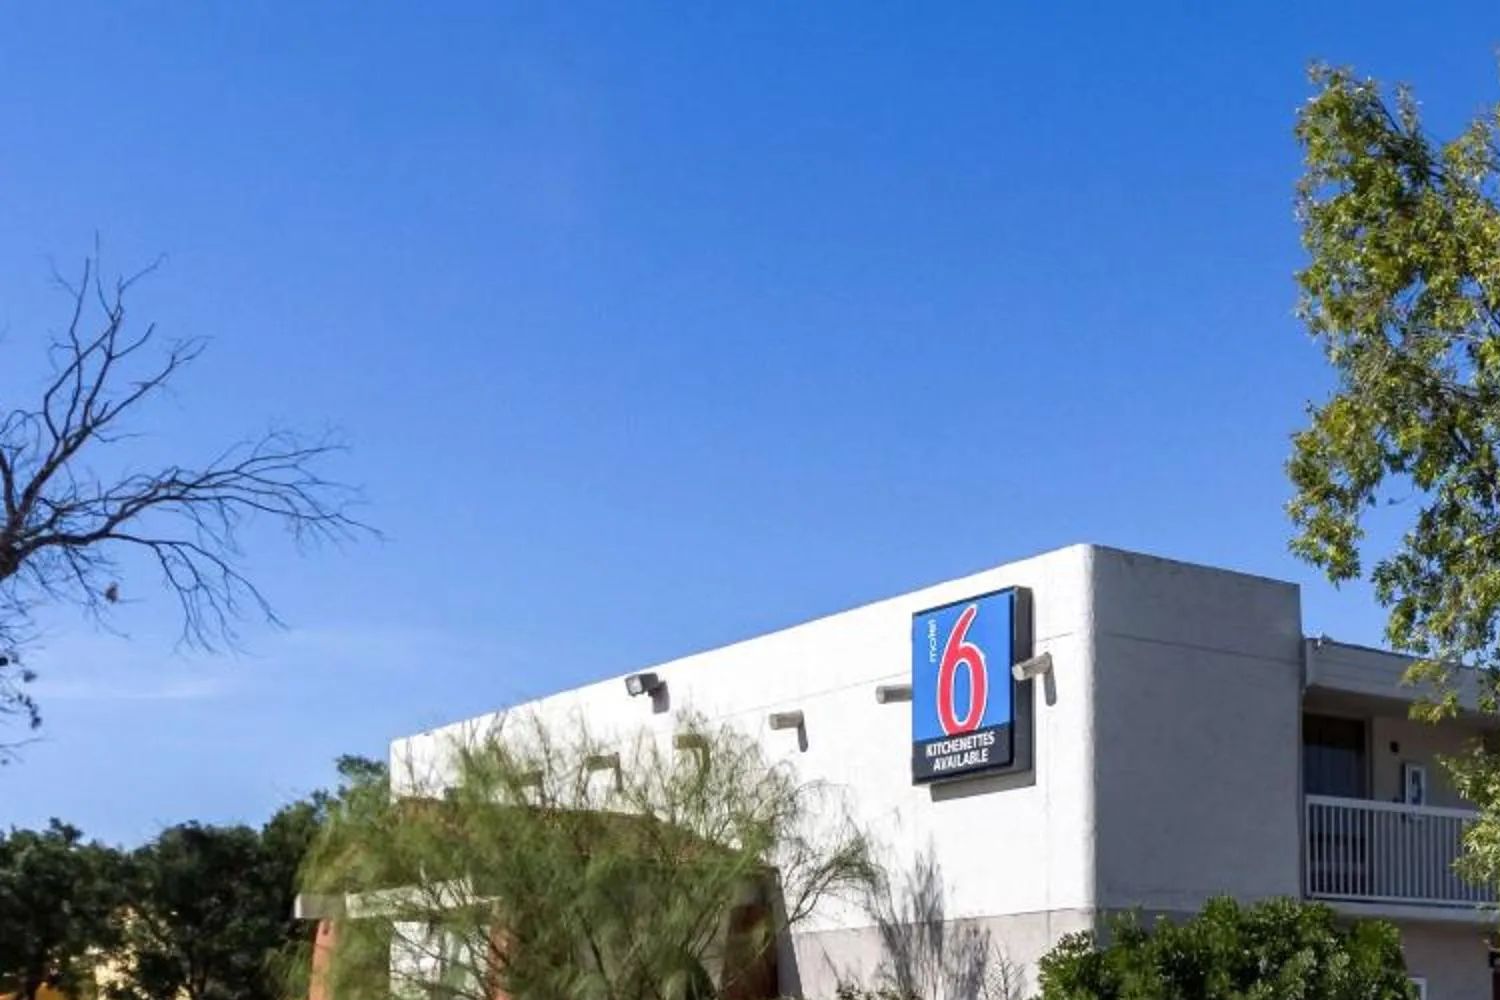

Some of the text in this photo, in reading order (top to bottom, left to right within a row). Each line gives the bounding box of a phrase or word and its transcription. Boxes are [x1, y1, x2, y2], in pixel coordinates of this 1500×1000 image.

[937, 604, 988, 735] 6
[925, 731, 995, 757] KITCHENETTES
[933, 748, 989, 771] AVAILABLE
